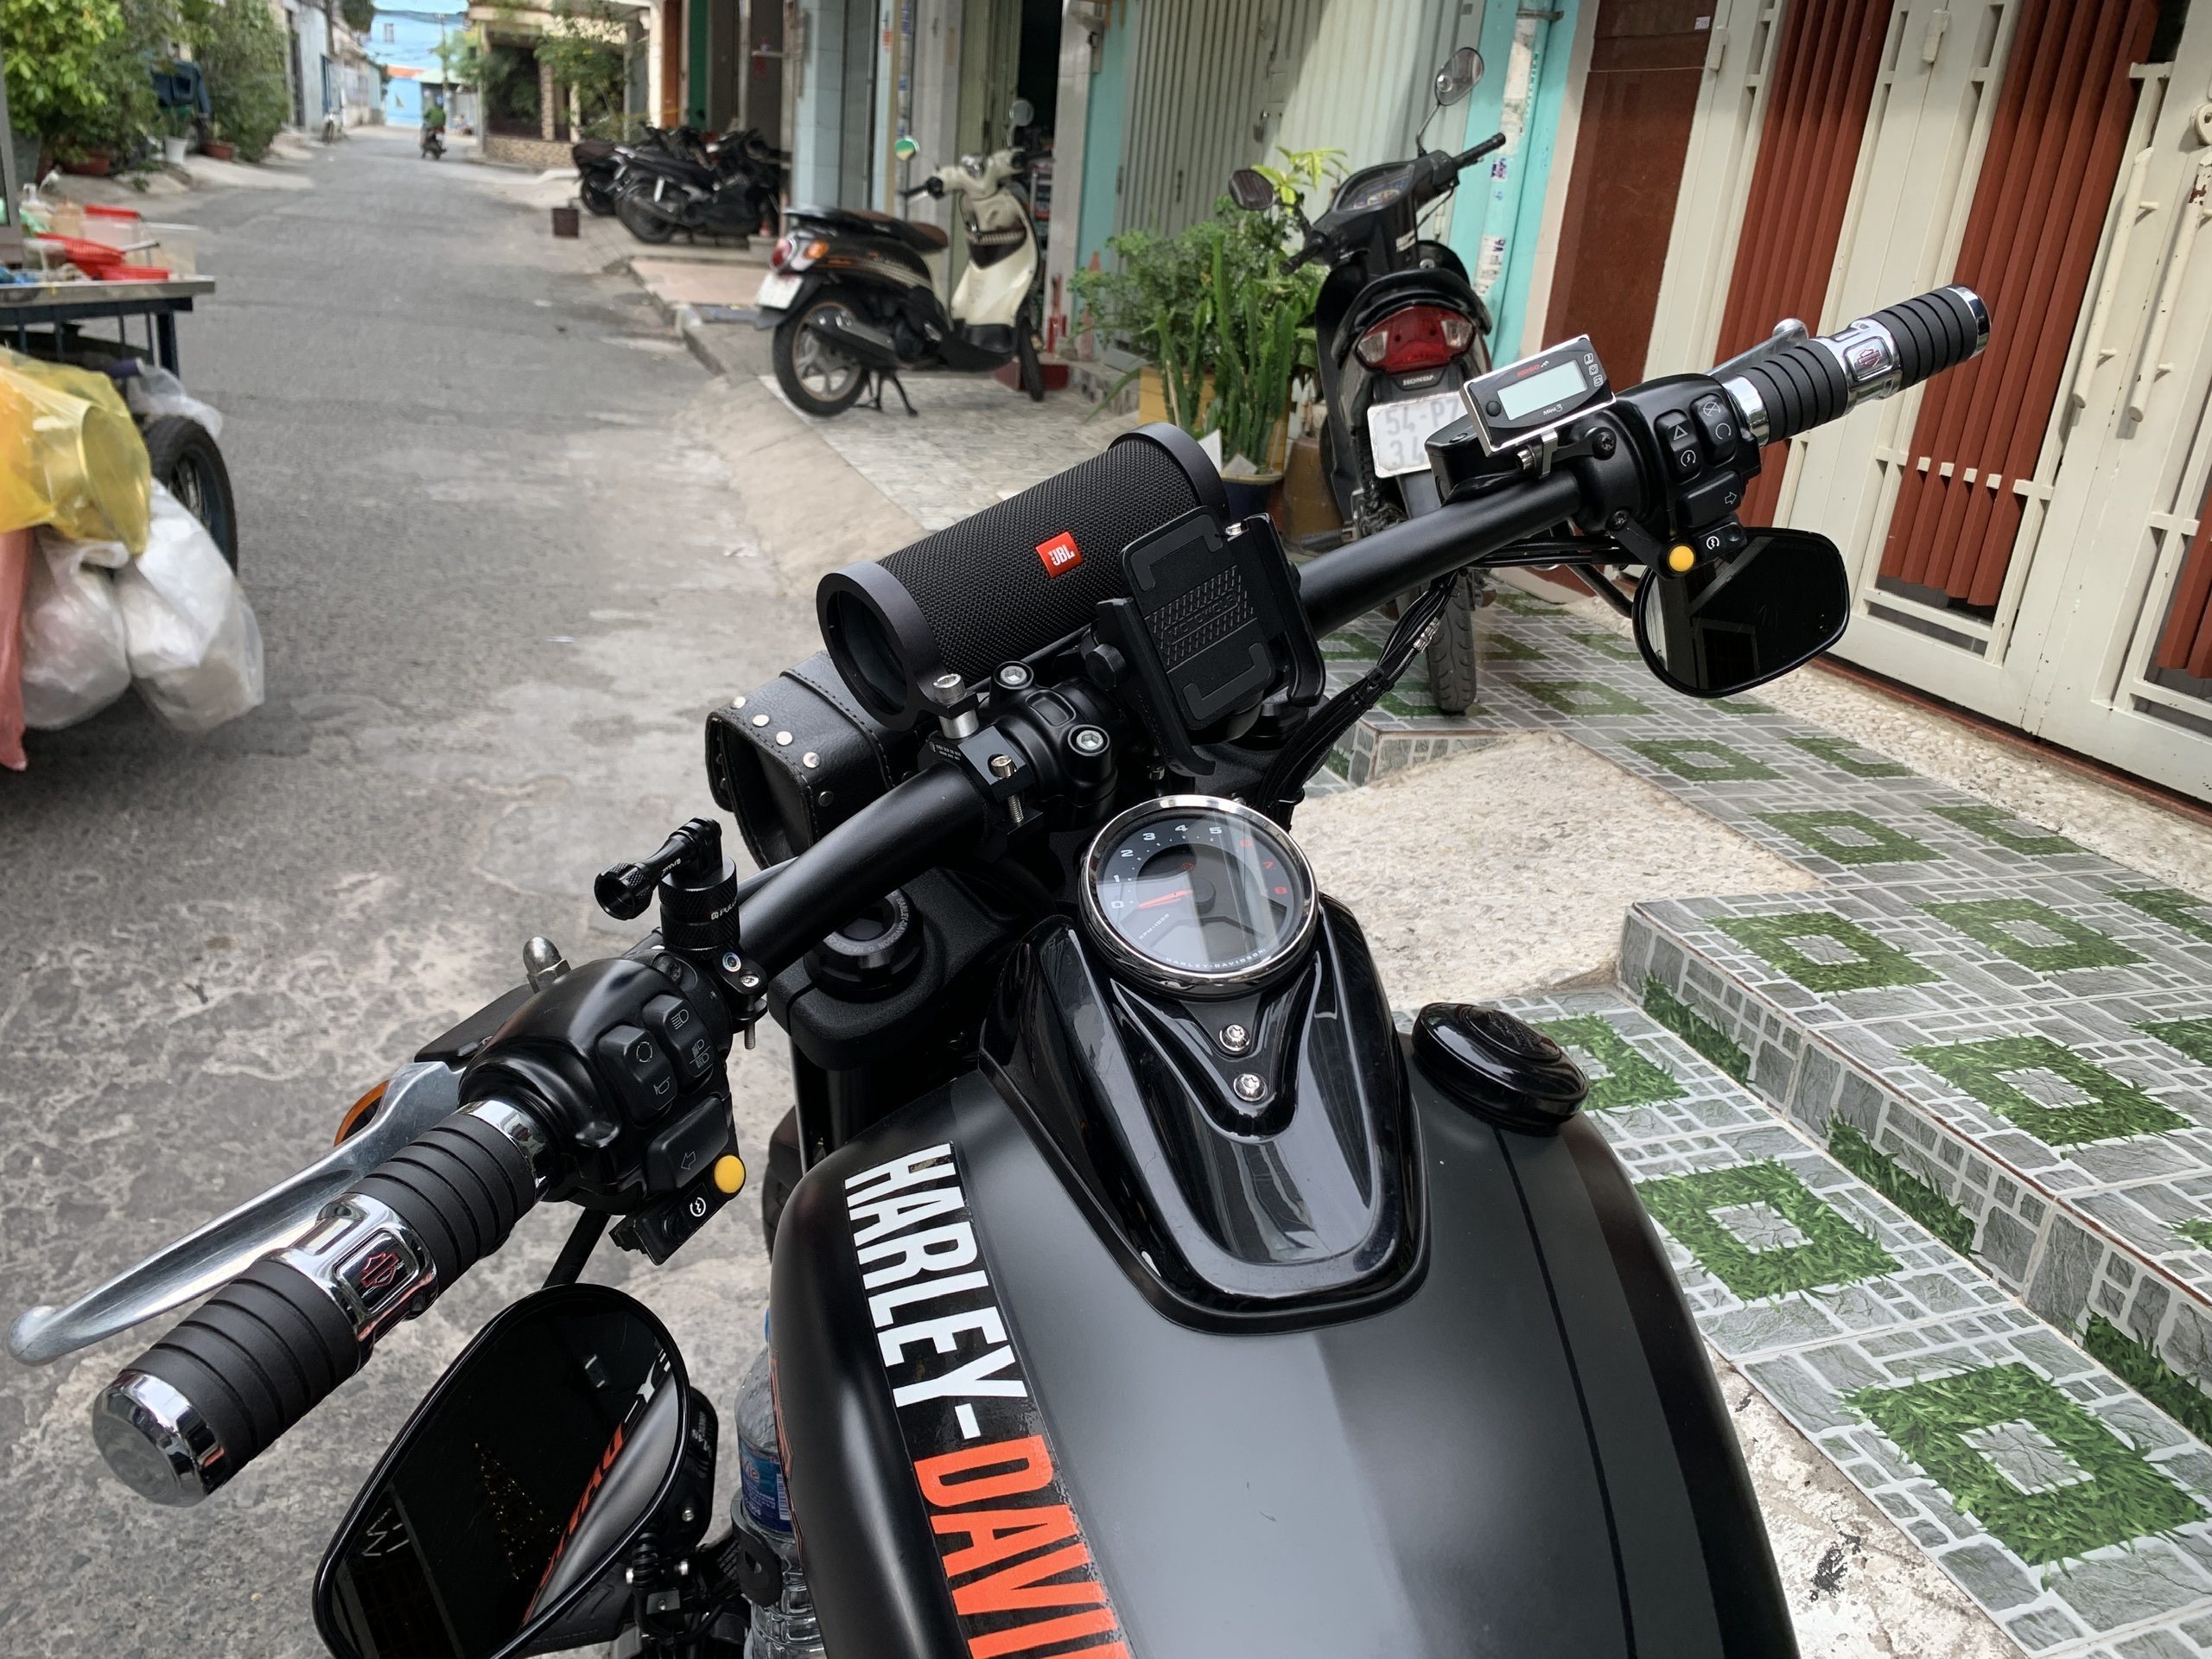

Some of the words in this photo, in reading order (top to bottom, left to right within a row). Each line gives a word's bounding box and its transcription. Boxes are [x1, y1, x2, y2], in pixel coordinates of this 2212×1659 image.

[1517, 364, 1541, 377] KOSO
[1402, 375, 1434, 386] HONDA
[1047, 544, 1076, 566] JBL
[1209, 826, 1223, 835] 5
[1142, 832, 1156, 841] 3
[1240, 839, 1253, 848] 6
[1121, 849, 1134, 857] 2
[1262, 861, 1274, 869] 7
[1113, 874, 1120, 883] 1
[830, 935, 864, 953] HARLEY-D
[844, 1143, 1132, 1659] HARLEY-DAVI
